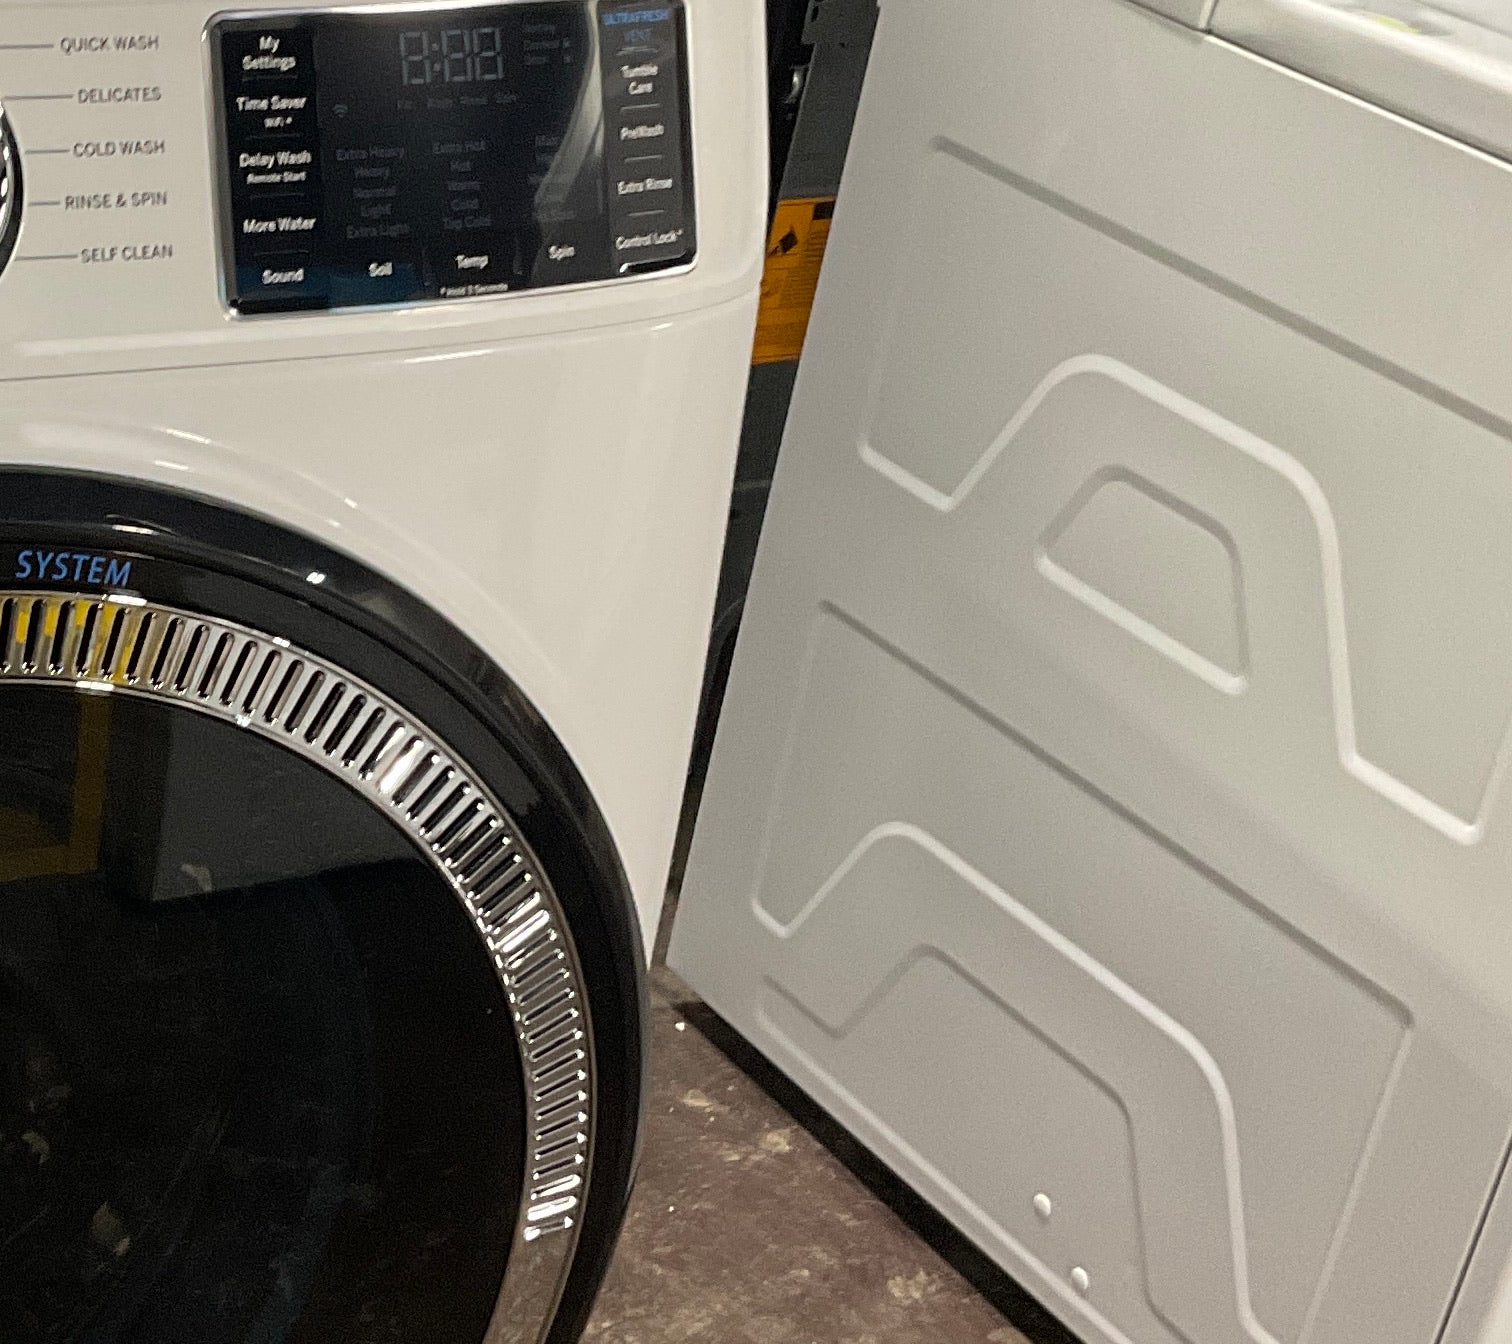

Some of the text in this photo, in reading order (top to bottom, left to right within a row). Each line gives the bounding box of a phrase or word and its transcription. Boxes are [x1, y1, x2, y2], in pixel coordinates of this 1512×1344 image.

[60, 35, 159, 55] QUICK WASH
[259, 36, 280, 53] My
[242, 55, 296, 71] Settings
[77, 86, 162, 104] DELICATES
[236, 95, 307, 111] Time Saver
[73, 140, 166, 158] COLD WASH
[239, 150, 312, 169] Delay Wash
[65, 191, 167, 211] RINSE & SPIN
[243, 217, 316, 233] More Water
[81, 244, 173, 263] SELF CLEAN
[549, 245, 575, 261] Spin
[368, 262, 393, 277] Soil
[455, 254, 488, 270] Temp
[262, 268, 304, 284] Sound
[15, 549, 132, 587] SYSTEM
